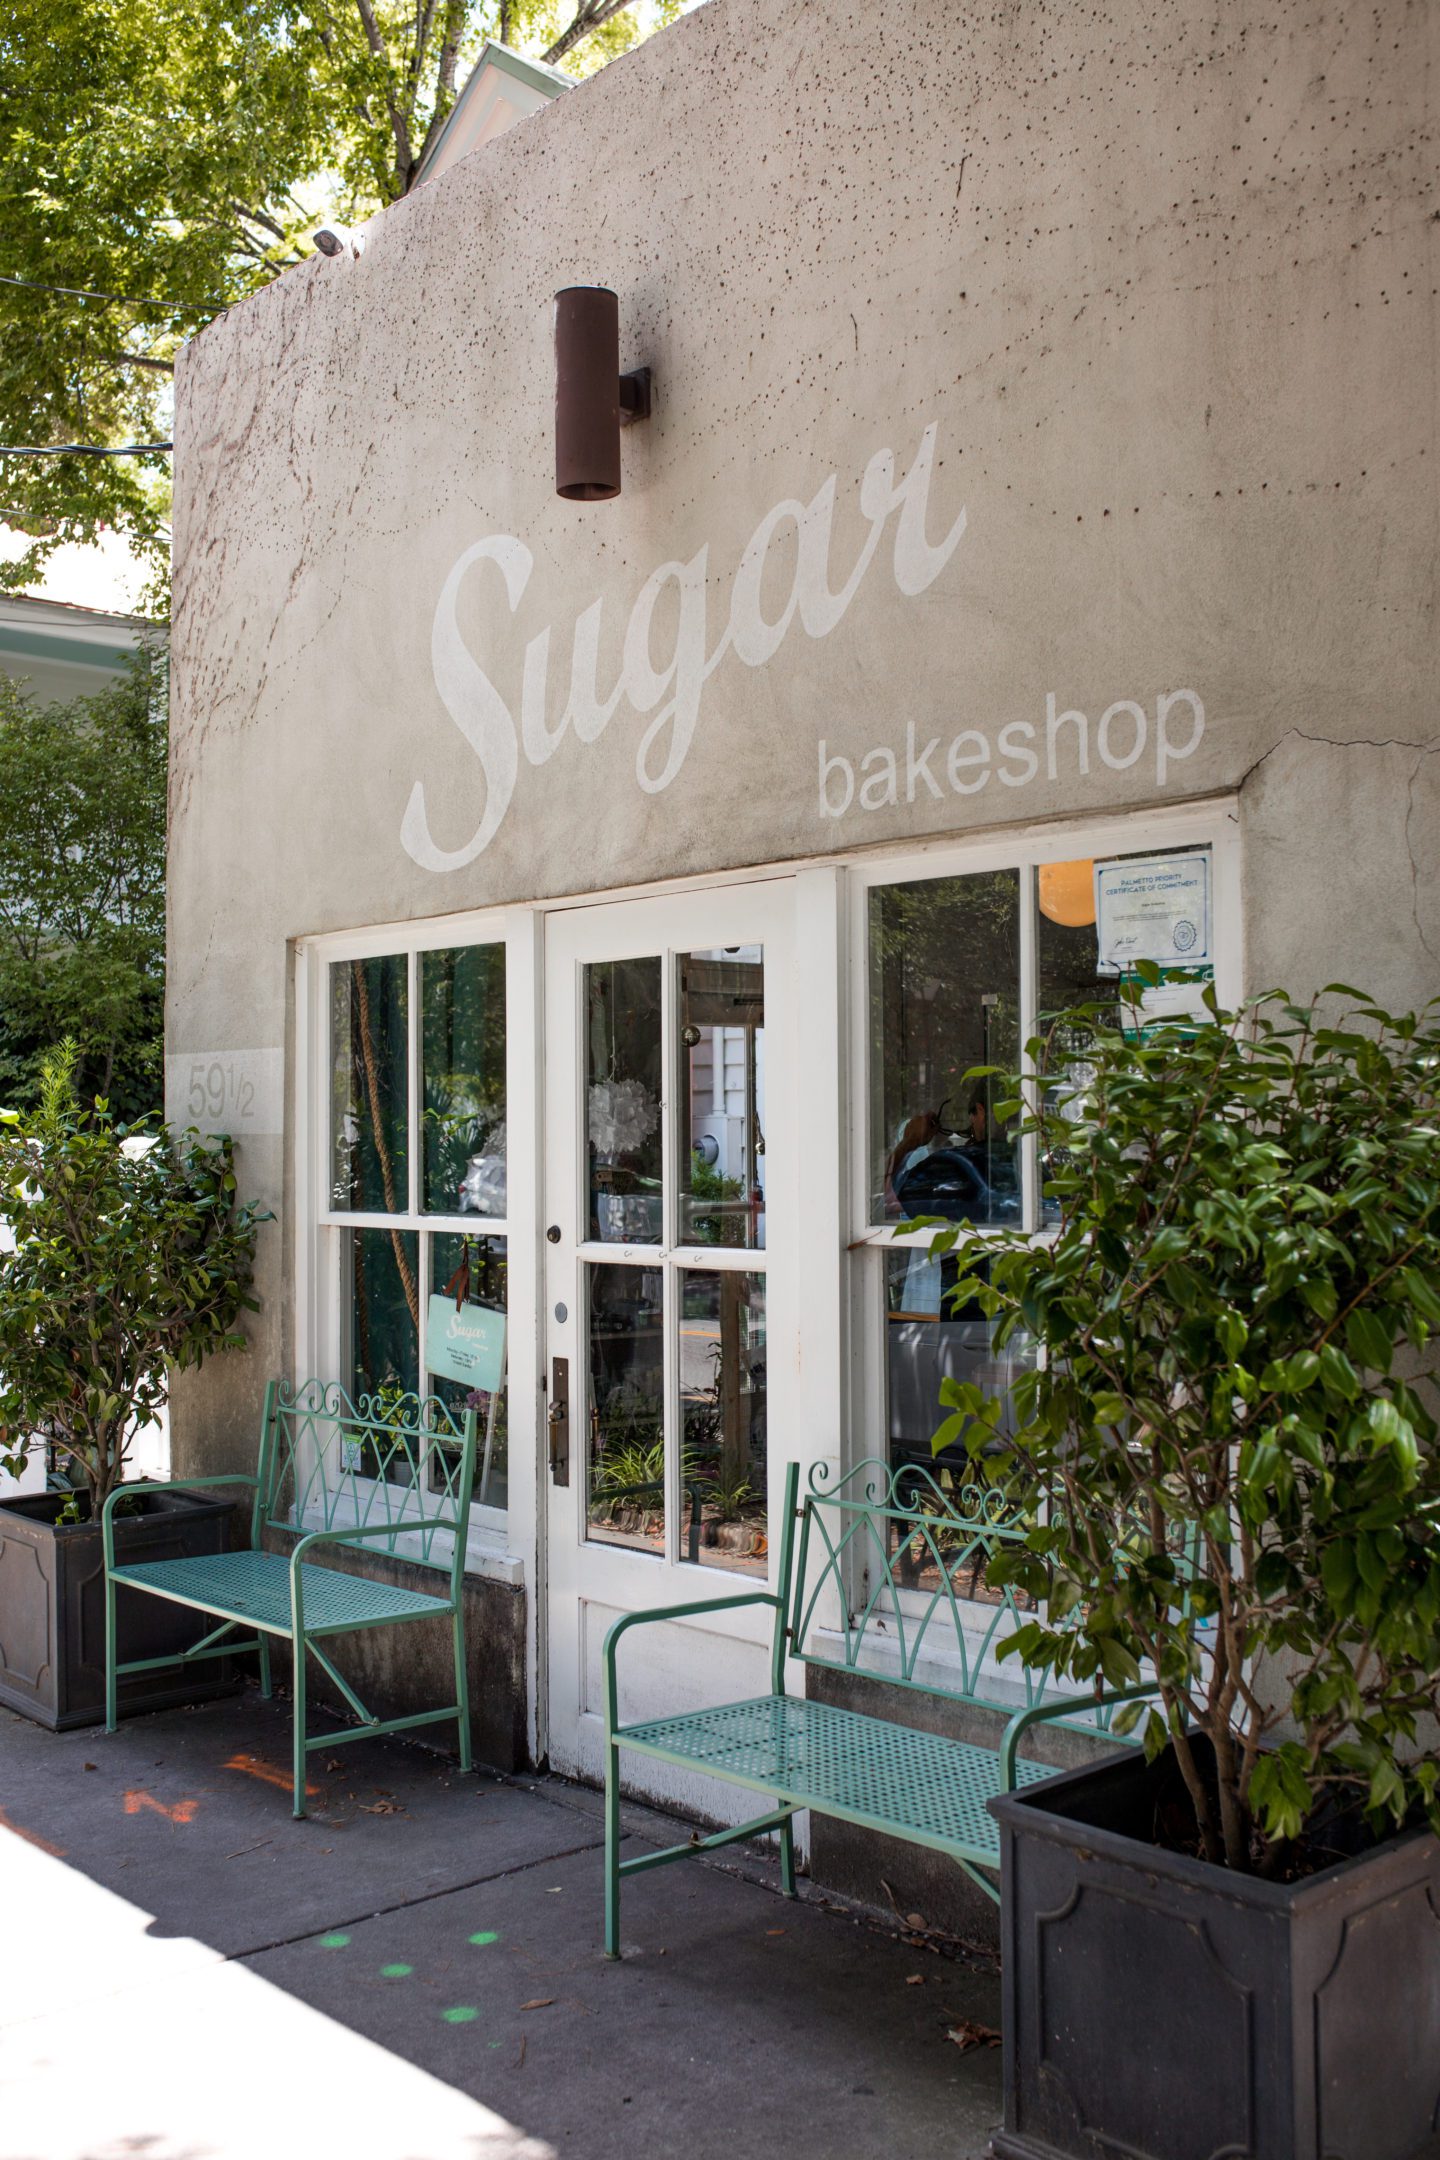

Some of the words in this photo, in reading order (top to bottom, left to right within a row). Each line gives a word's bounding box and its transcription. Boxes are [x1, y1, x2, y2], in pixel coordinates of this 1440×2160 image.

[400, 420, 968, 872] Sugar
[818, 688, 1206, 818] bakeshop
[1106, 886, 1146, 896] CERTIFICATE
[1147, 884, 1156, 892] OF
[1158, 880, 1198, 891] COMMITMENT
[1121, 877, 1154, 886] PALMETTO
[1155, 874, 1182, 882] PRIORITY
[446, 1314, 486, 1342] Sugar
